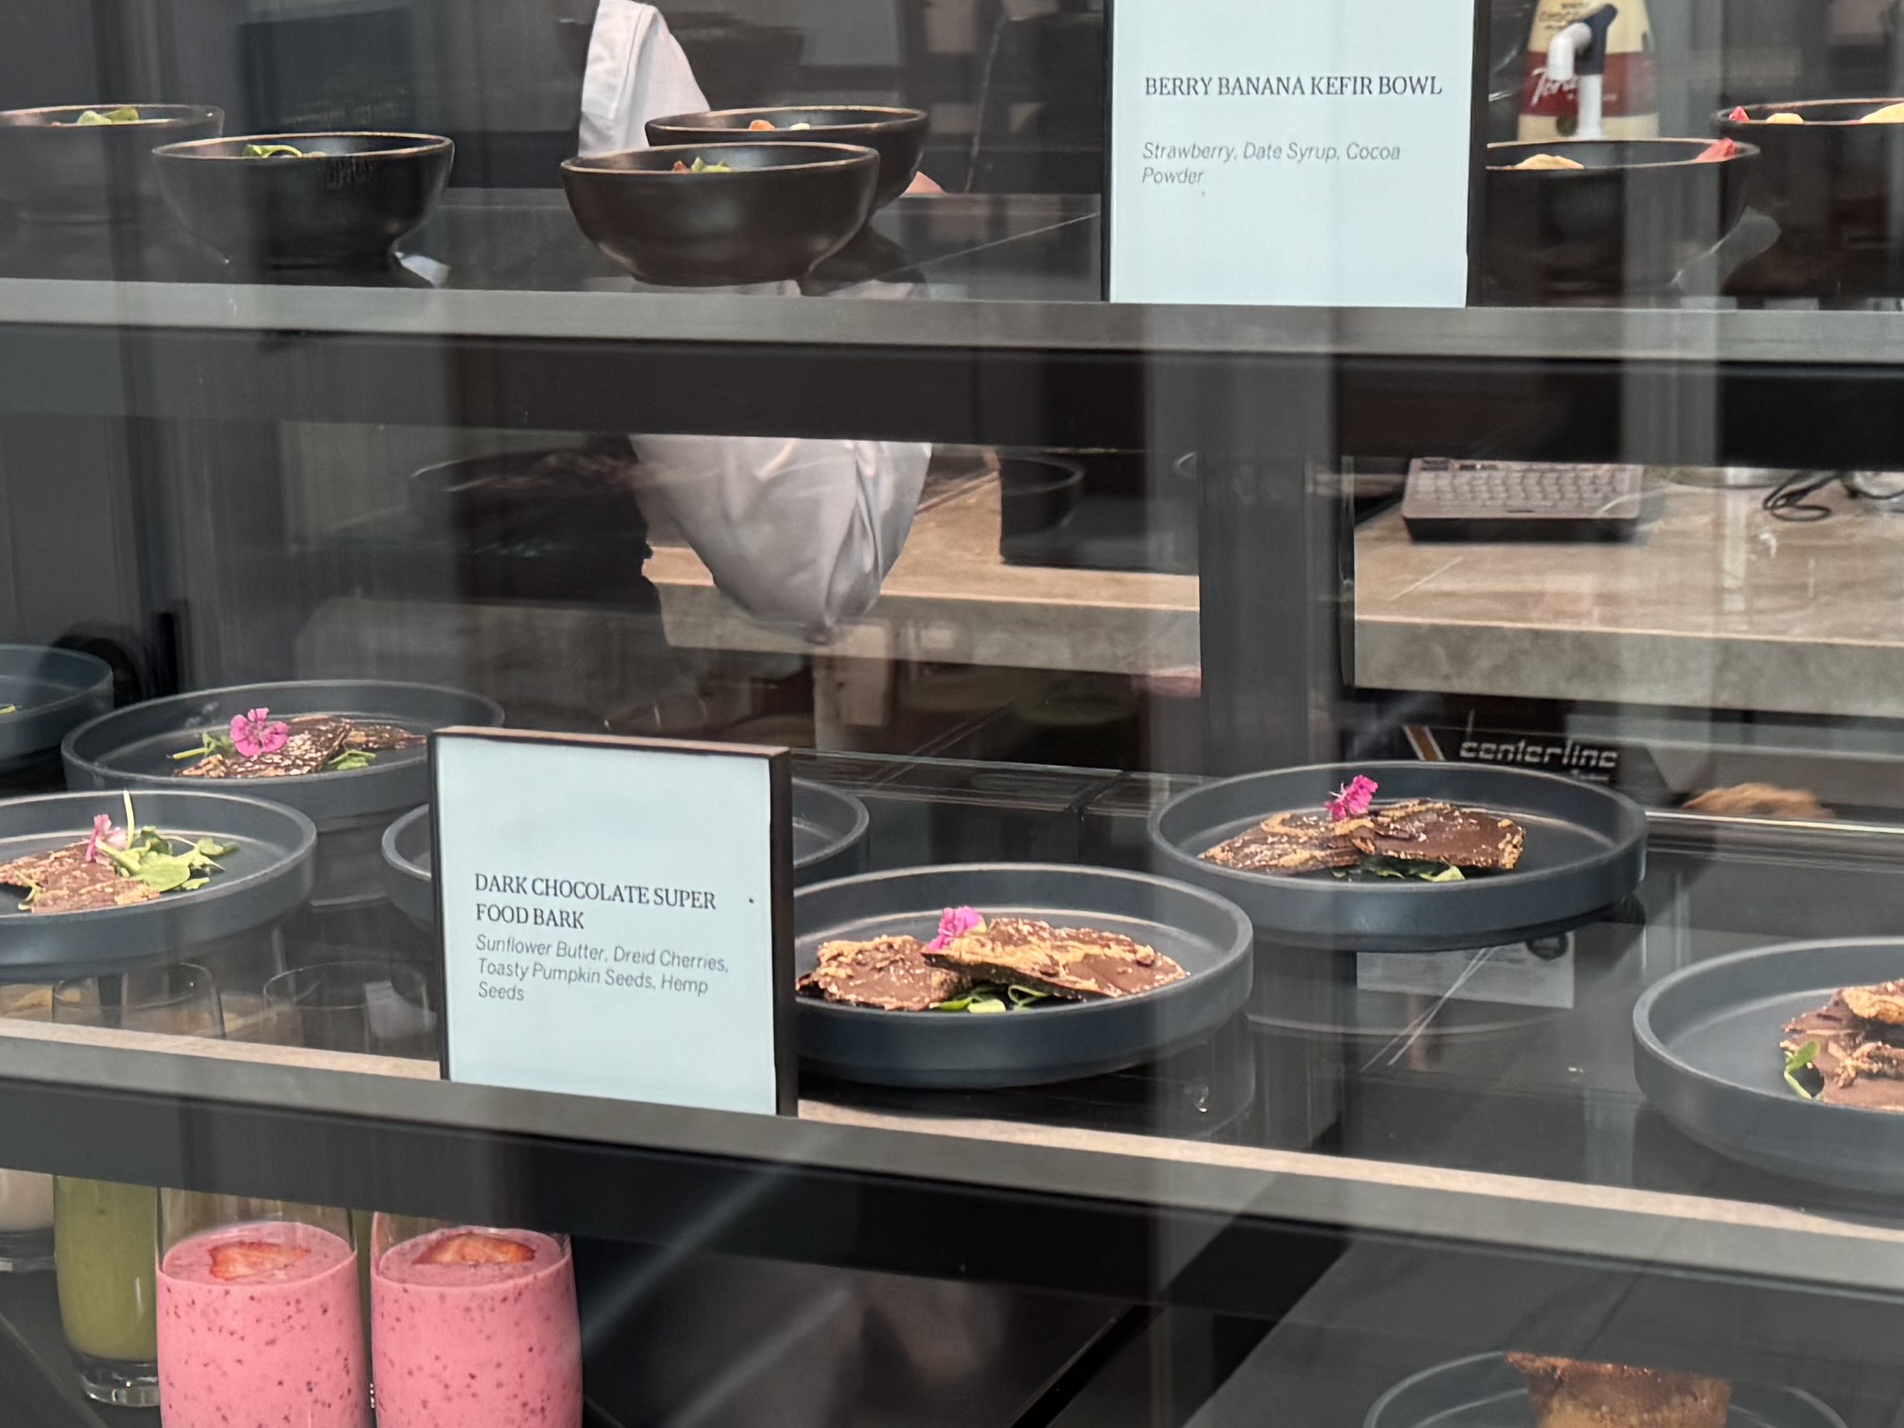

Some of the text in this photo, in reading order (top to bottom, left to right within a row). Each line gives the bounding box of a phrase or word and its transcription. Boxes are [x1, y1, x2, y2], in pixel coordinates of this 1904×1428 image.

[1145, 76, 1442, 96] BERRY BANANA KEFIR BOWL
[1143, 142, 1400, 163] Strawberry, Date Syrup, Cocoa
[1142, 166, 1203, 184] Powder
[475, 873, 716, 910] DARK CHOCOLATE SUPER
[476, 904, 584, 929] FOOD BARK
[476, 934, 728, 972] Sunflower Butter, Dreid Cherries,
[478, 958, 708, 997] Toasty Pumpkin Seeds, Hemp
[478, 982, 524, 1002] Seeds
